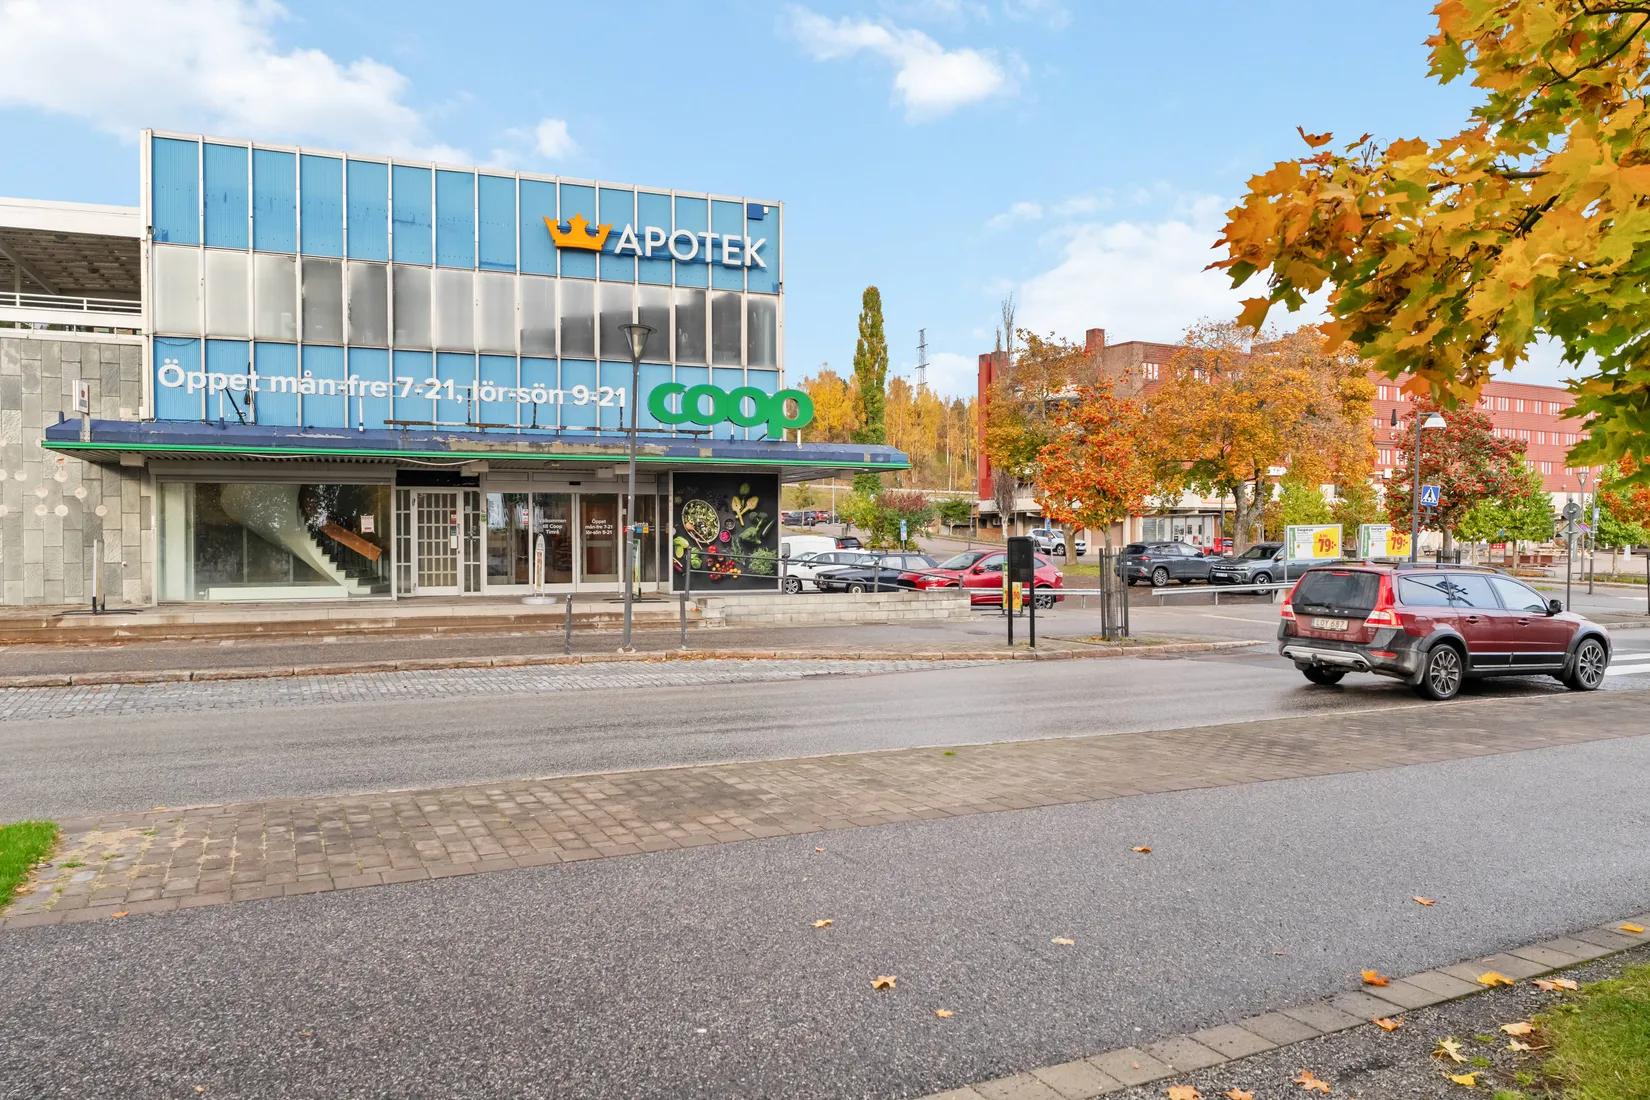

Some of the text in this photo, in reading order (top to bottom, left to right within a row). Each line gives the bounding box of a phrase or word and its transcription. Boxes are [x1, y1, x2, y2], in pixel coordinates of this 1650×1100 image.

[613, 223, 767, 268] APOTEK
[157, 358, 626, 407] Öppet mån-fre 7-21, lör-sön 9-21
[647, 382, 815, 438] coop
[1331, 619, 1345, 629] 687
